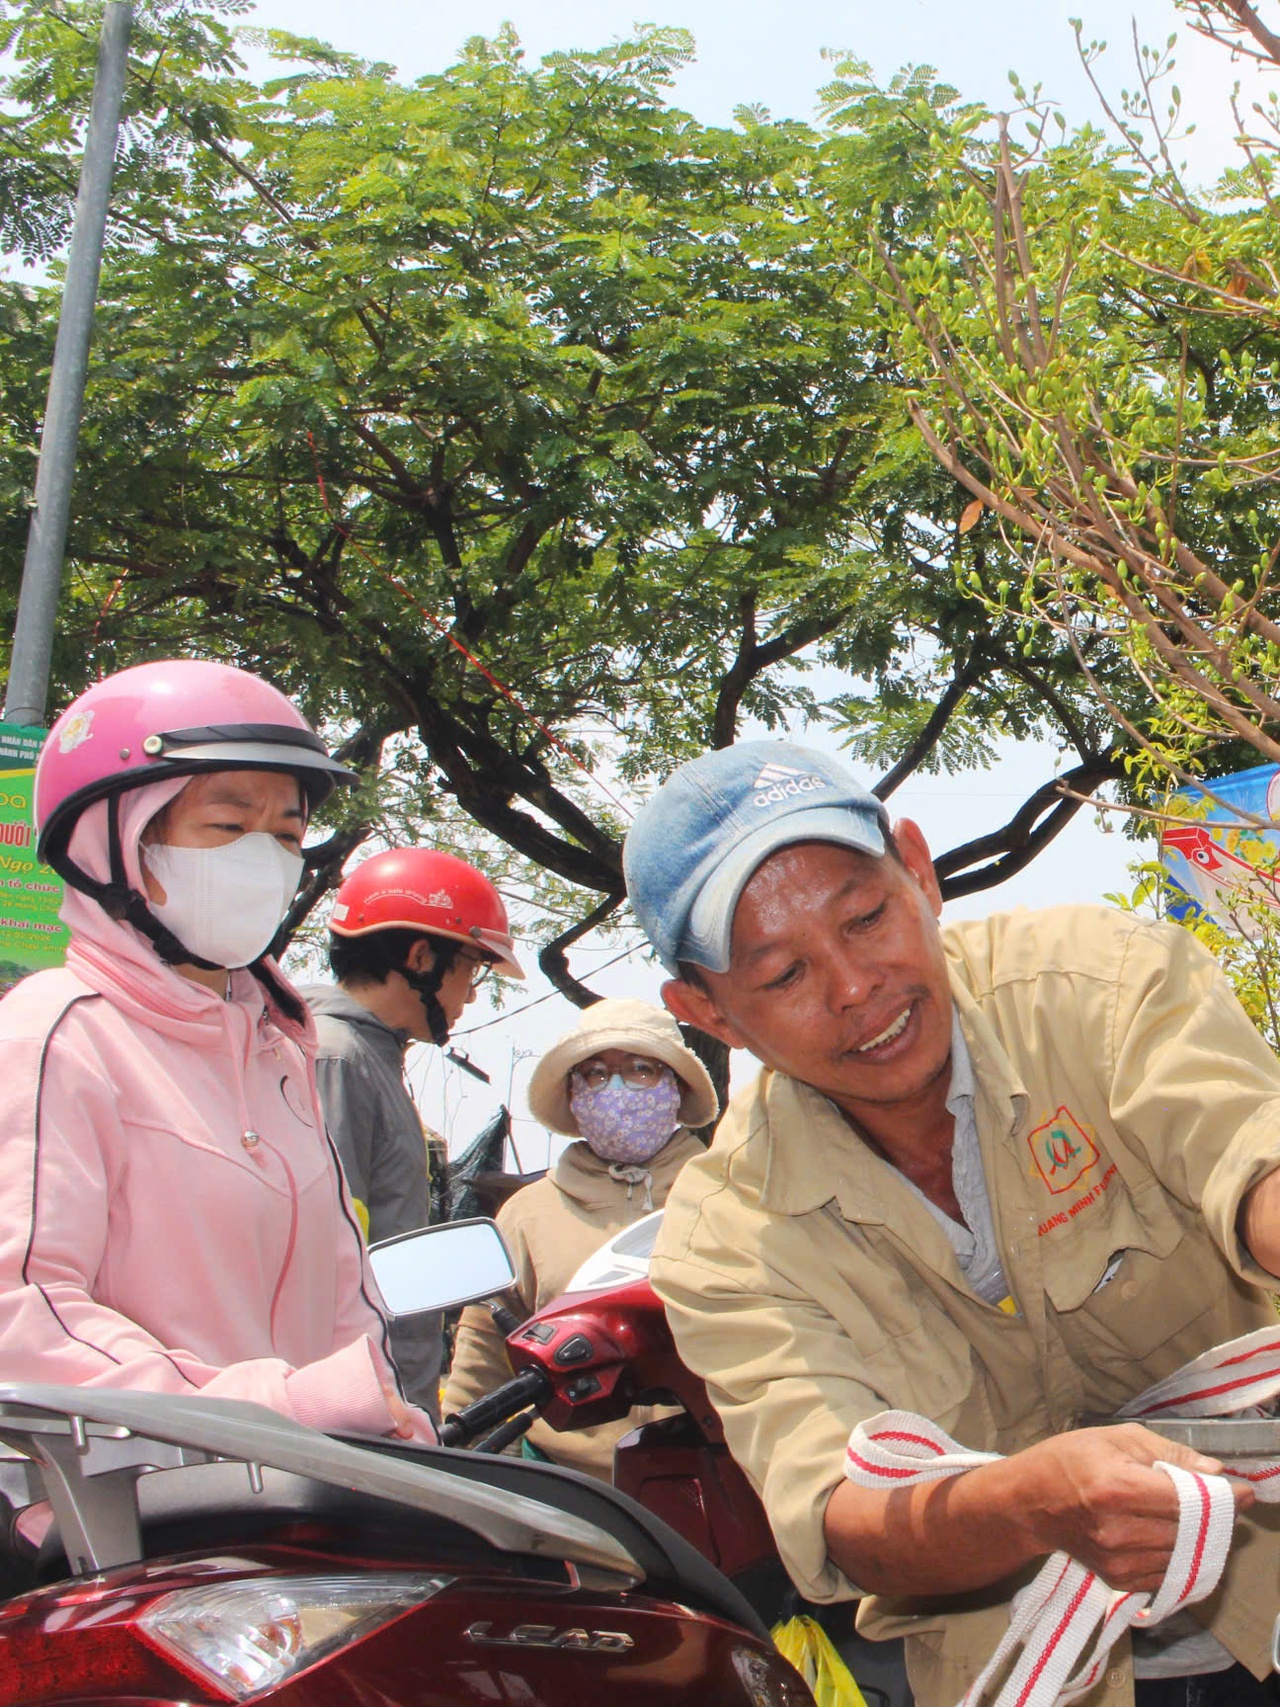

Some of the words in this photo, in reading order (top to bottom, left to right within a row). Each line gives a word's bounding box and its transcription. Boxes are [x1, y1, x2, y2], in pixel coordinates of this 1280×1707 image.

[753, 777, 826, 807] adidas
[25, 881, 61, 893] chức
[0, 917, 29, 930] khai
[33, 923, 63, 935] mạc
[1068, 1192, 1095, 1218] MINH
[463, 1620, 635, 1653] LEAD
